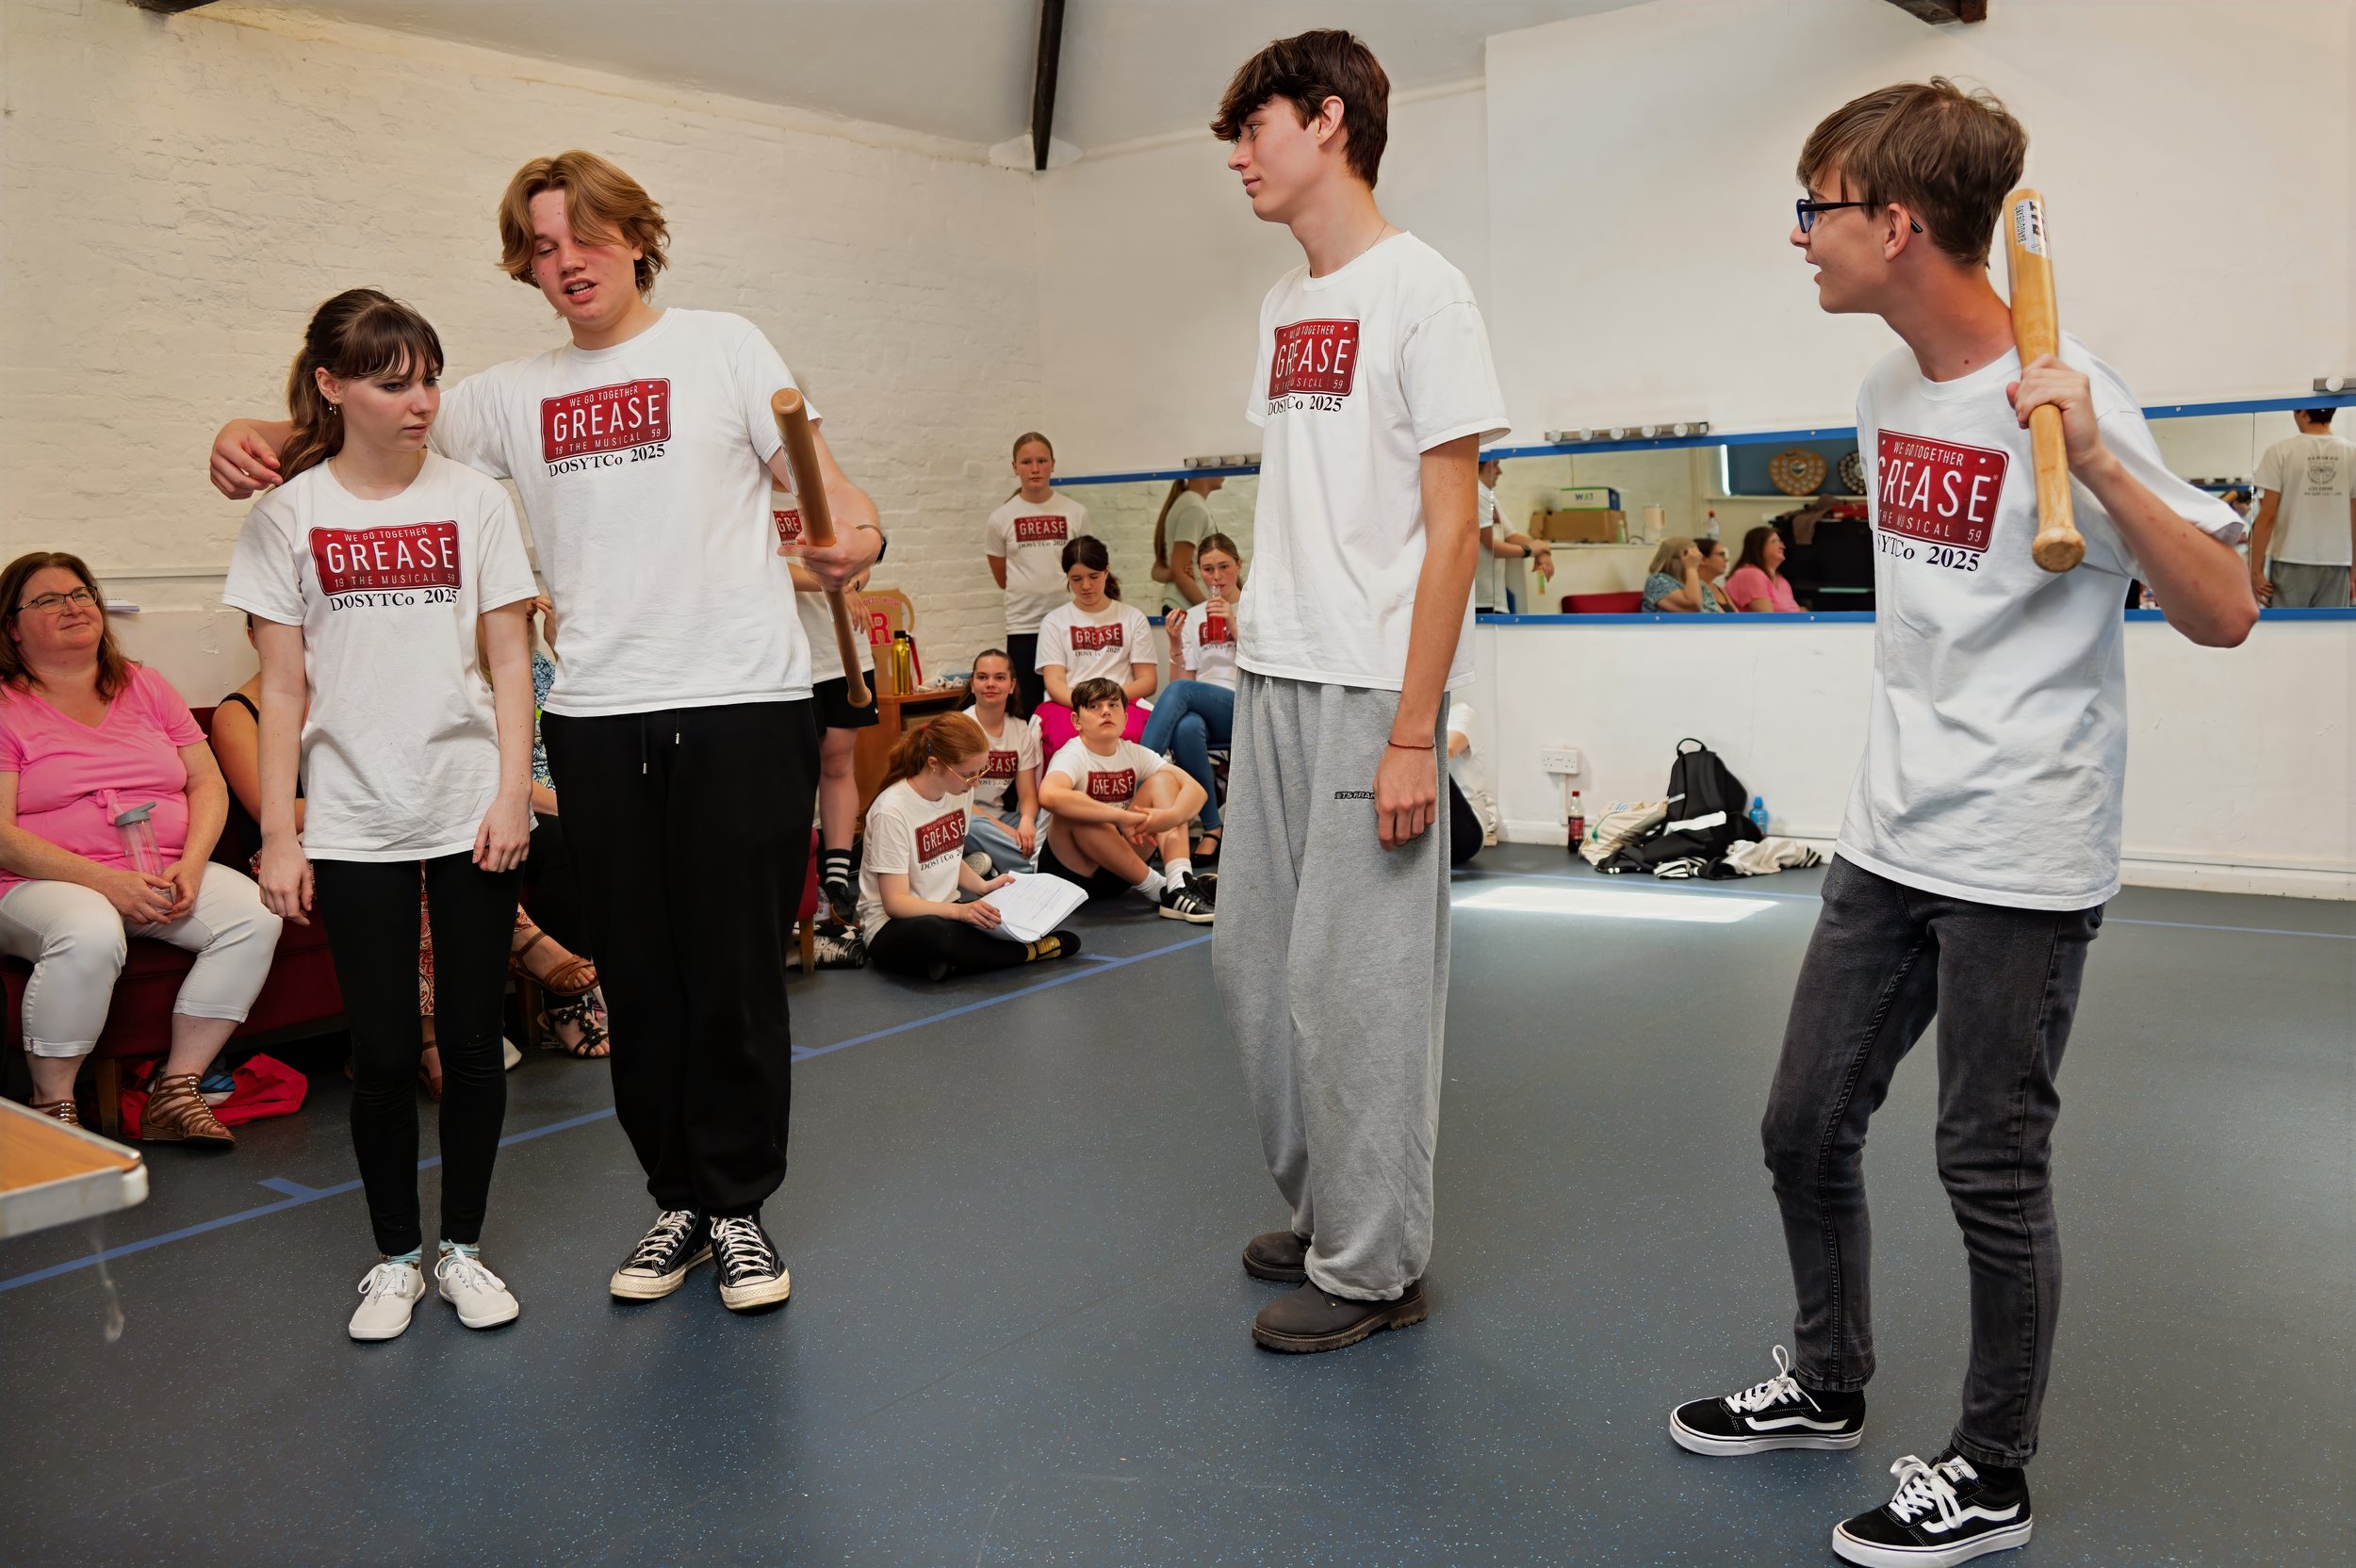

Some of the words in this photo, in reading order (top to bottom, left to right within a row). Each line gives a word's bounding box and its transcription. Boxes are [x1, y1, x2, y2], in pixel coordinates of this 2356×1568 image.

[1275, 337, 1351, 379] GREASE
[569, 397, 581, 408] WE
[584, 394, 595, 405] GO
[597, 384, 639, 402] TOGETHER
[1333, 379, 1344, 390] 59
[1309, 395, 1343, 413] 2025
[553, 394, 661, 443] GREASE
[569, 441, 588, 452] THE
[595, 432, 641, 449] MUSICAL
[651, 428, 662, 438] 59
[548, 453, 623, 478] DOSYTCo
[630, 443, 666, 463] 2025
[1893, 441, 1905, 455] WE
[1914, 444, 1964, 467] TOGETHER
[344, 532, 358, 543] WE
[363, 531, 376, 541] GO
[380, 527, 428, 540] TOGETHER
[776, 516, 801, 532] GRE
[1019, 520, 1066, 535] GREASE
[1967, 529, 1982, 543] 59
[326, 537, 454, 574] GREASE
[1925, 546, 1981, 572] 2025
[335, 578, 345, 588] 19
[351, 576, 374, 586] THE
[382, 572, 437, 585] MUSICAL
[447, 573, 456, 582] 59
[330, 592, 415, 612] DOSYTCo
[423, 588, 458, 604] 2025
[870, 612, 893, 646] R
[1075, 627, 1121, 645] GREASE
[988, 757, 1017, 773] EASE
[923, 818, 965, 853] GREASE
